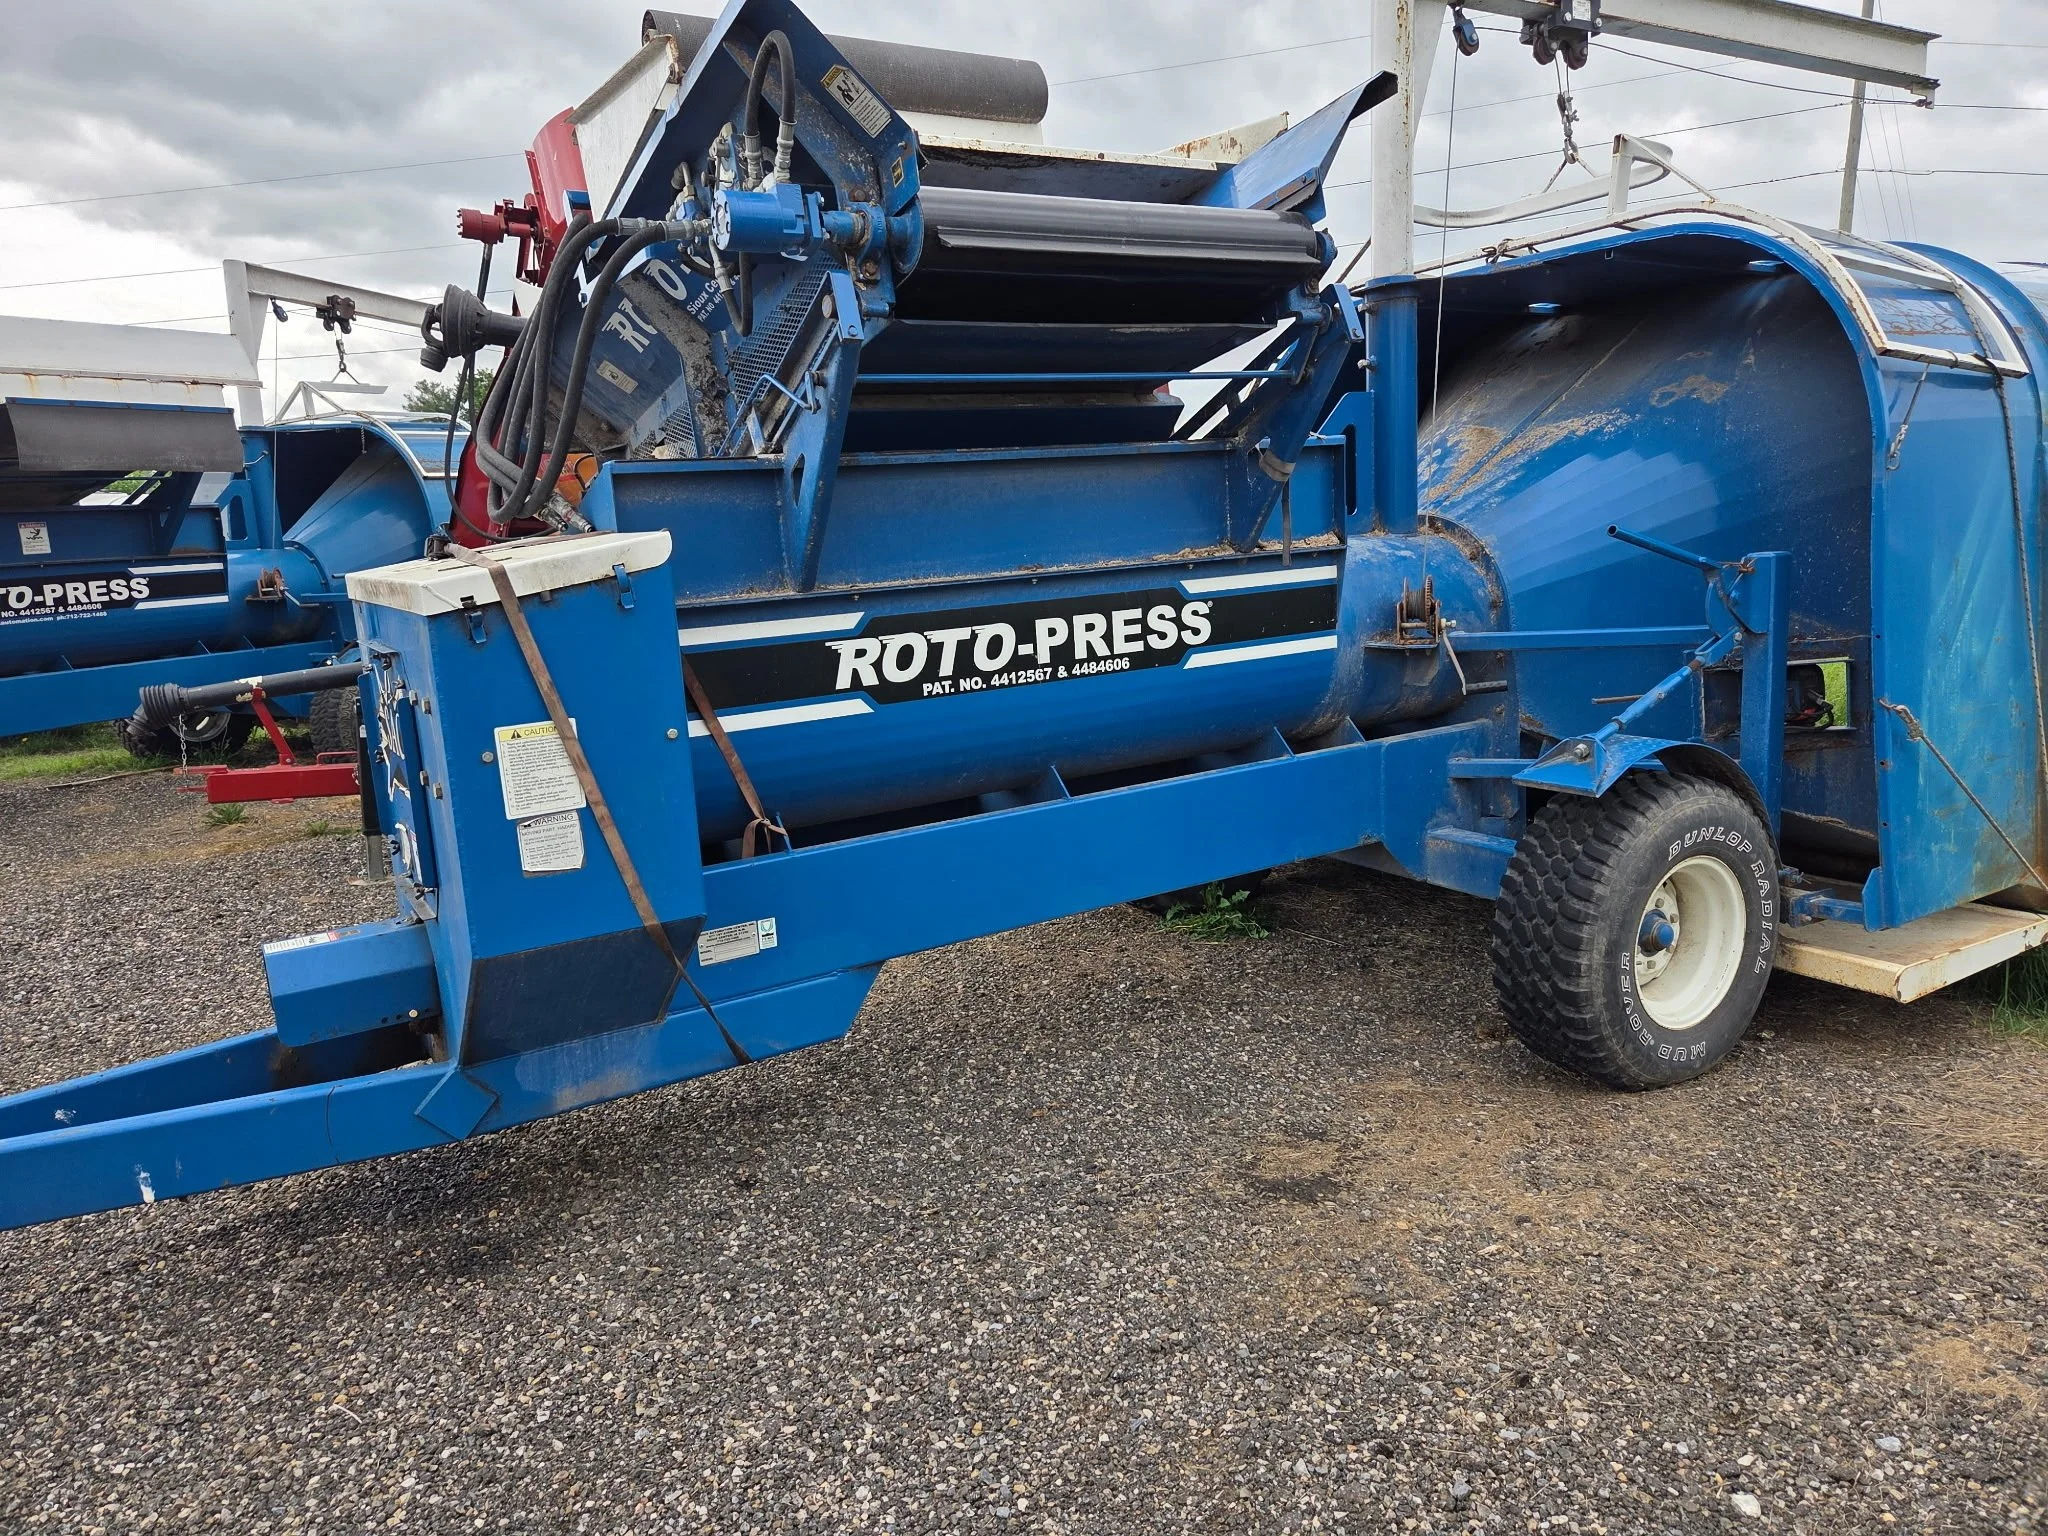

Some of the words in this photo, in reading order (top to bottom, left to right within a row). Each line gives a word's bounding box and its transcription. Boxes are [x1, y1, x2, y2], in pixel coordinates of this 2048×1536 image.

[0, 577, 149, 609] O-PRESS
[19, 607, 55, 616] 4412567
[923, 681, 955, 696] PAT.
[959, 676, 986, 692] NO.
[991, 667, 1052, 686] 4412567
[1057, 665, 1068, 678] &
[1072, 657, 1130, 676] 4484606
[1668, 827, 1752, 861] DUNLOP
[1751, 860, 1773, 974] RADIAL
[1621, 952, 1652, 1046] ROVER
[1658, 1041, 1706, 1061] MUD
